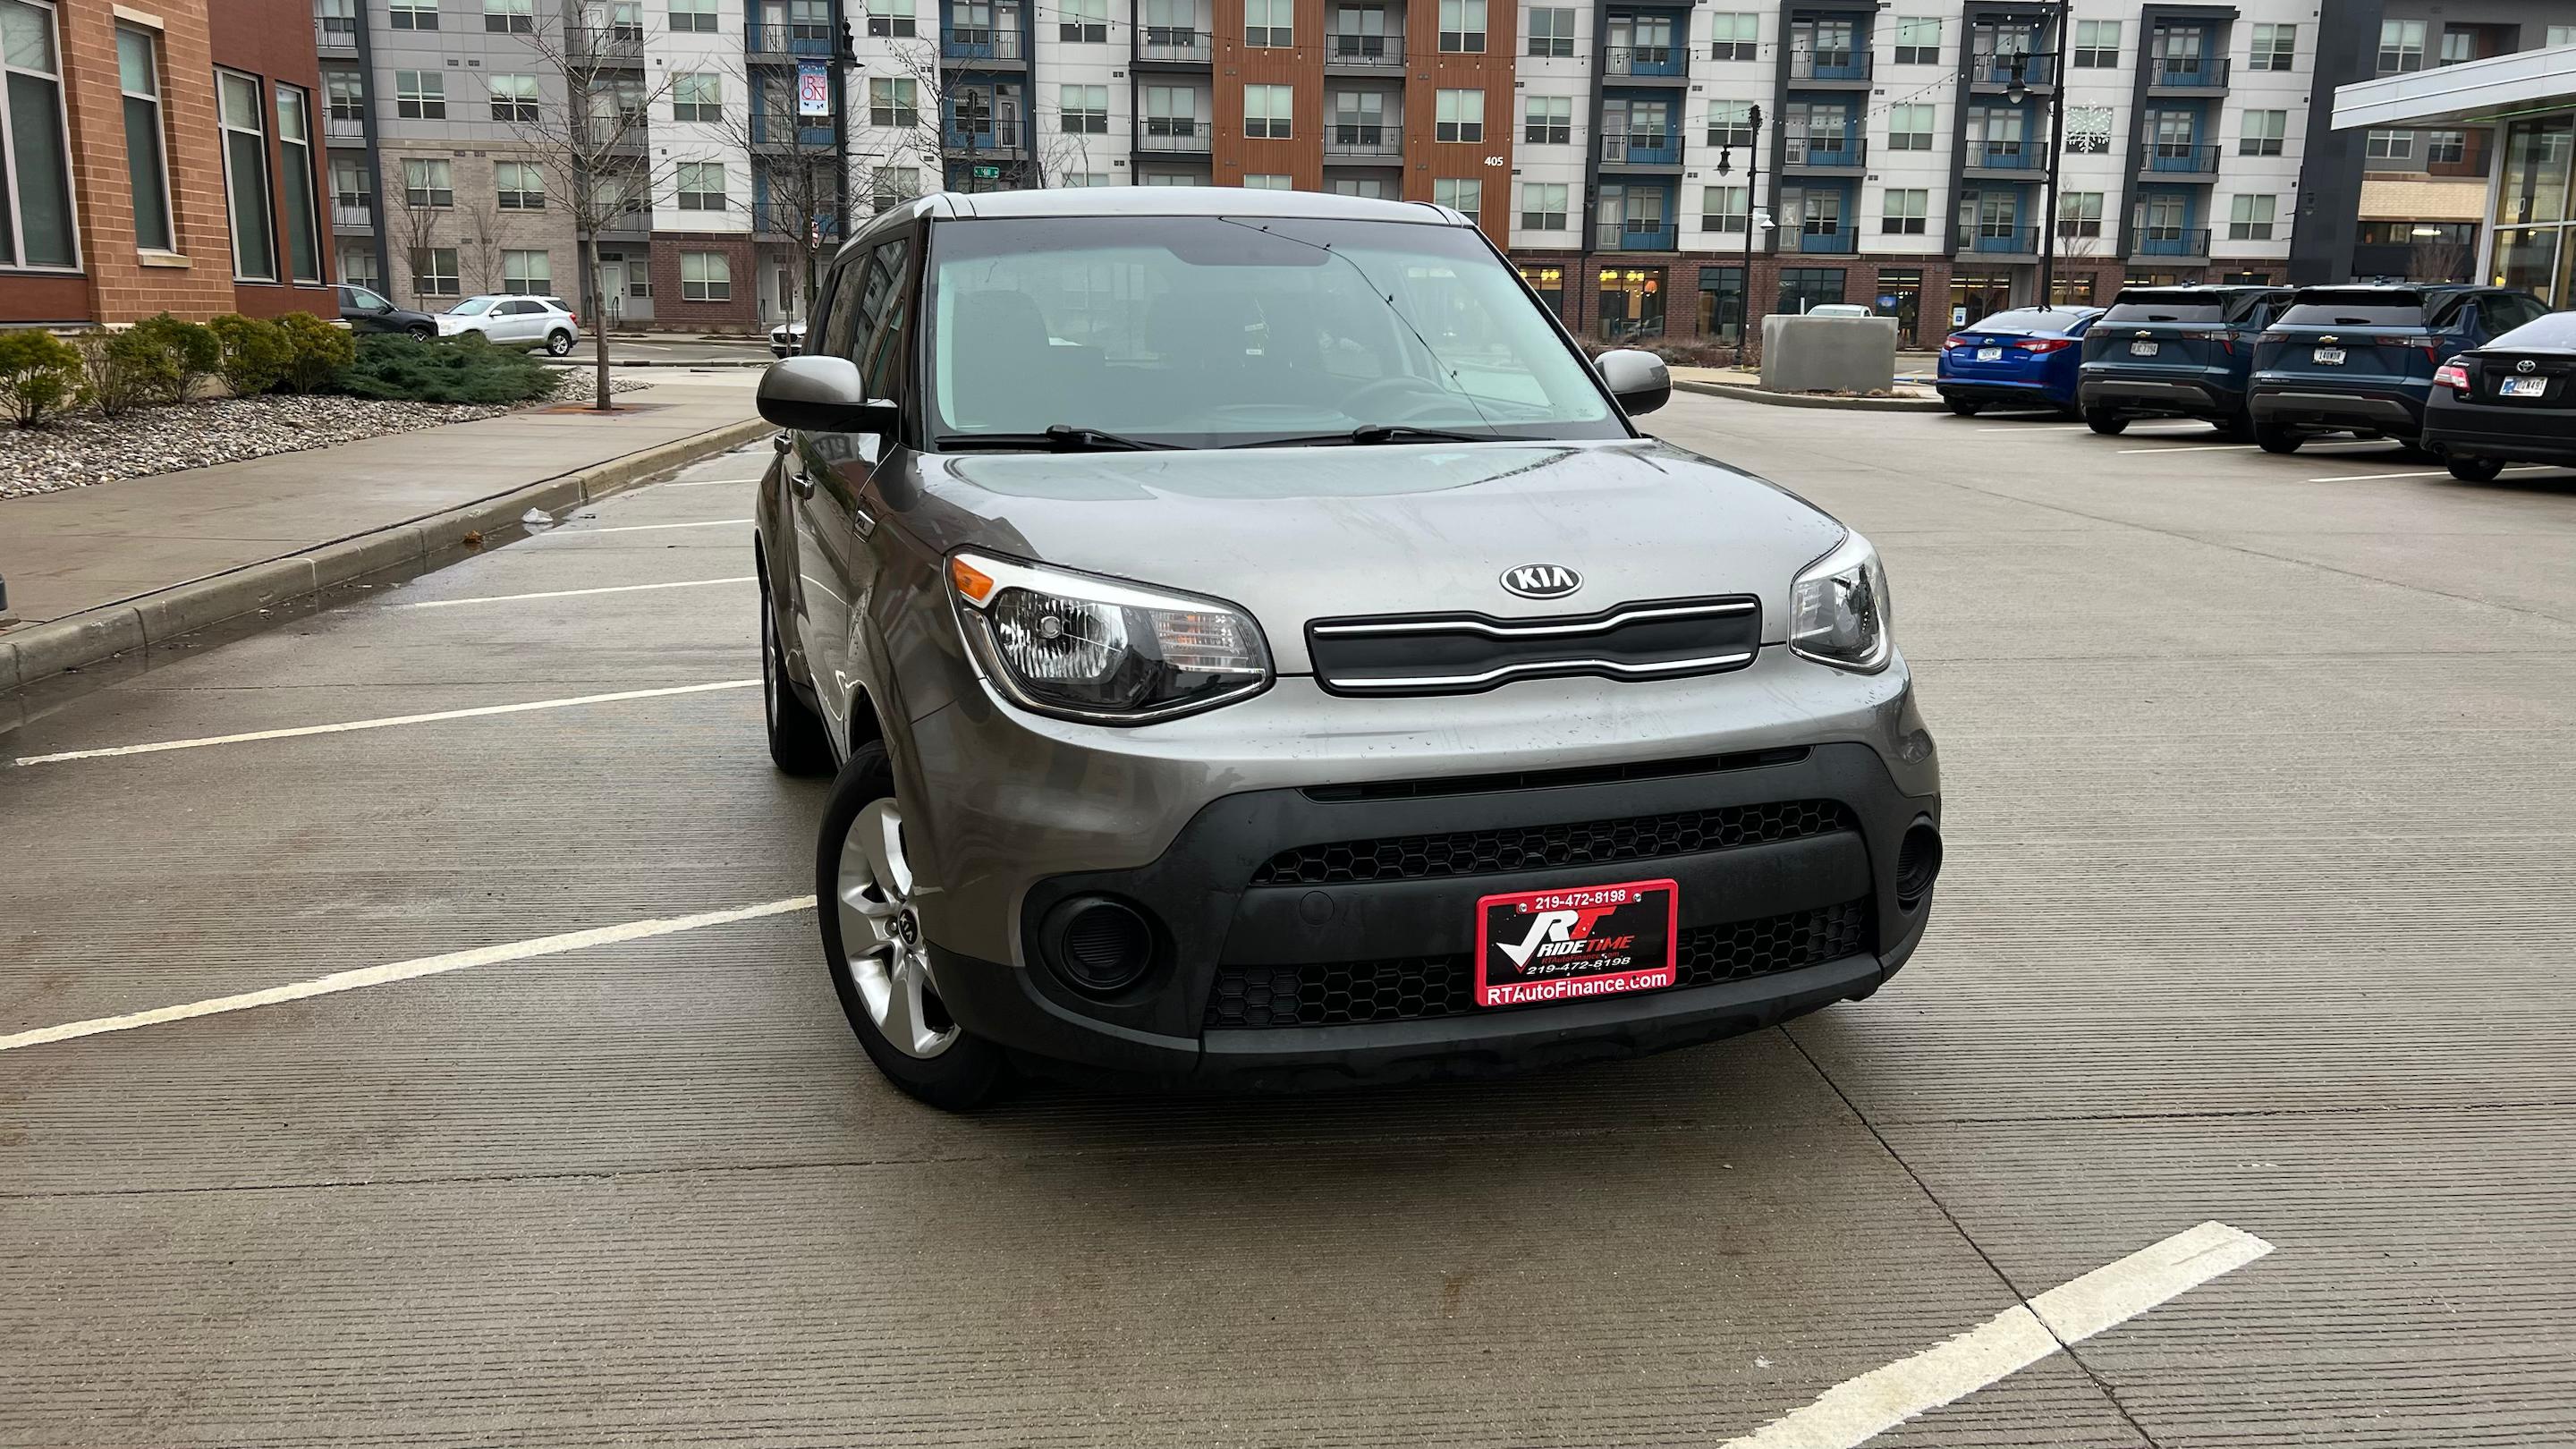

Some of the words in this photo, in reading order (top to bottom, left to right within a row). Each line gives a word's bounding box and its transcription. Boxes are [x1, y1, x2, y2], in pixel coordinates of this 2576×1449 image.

[1484, 156, 1504, 166] 405
[1513, 566, 1574, 589] KIA
[1535, 890, 1626, 910] 219-472-8198
[900, 913, 913, 941] KIA
[1526, 956, 1631, 975] 219-472-8198
[1541, 951, 1620, 964] RTAutoFinancecom
[1487, 973, 1667, 1005] RTAutoFinance.com
